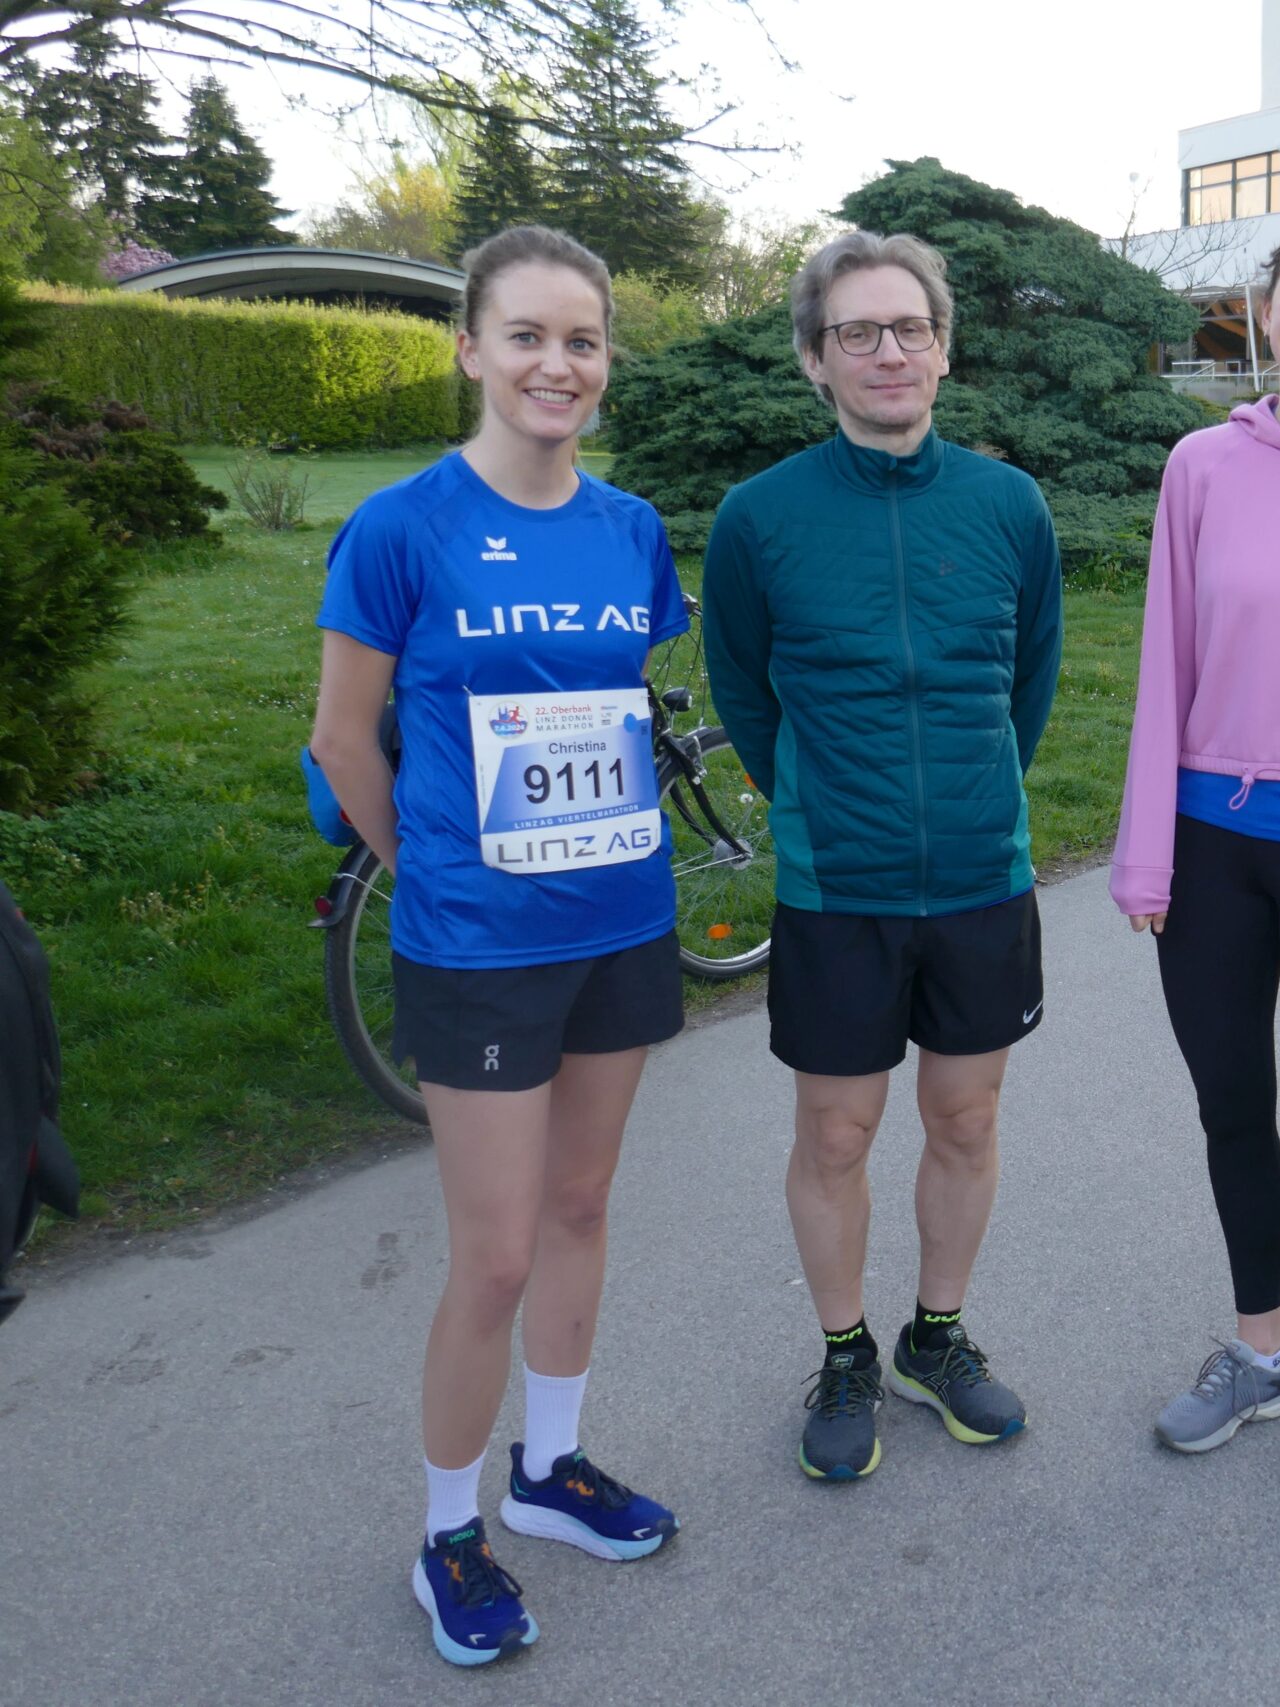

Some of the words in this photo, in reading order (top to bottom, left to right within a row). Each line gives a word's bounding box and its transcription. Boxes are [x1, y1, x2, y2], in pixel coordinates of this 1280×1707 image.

[481, 551, 517, 561] erima
[456, 604, 585, 637] LINZ
[596, 605, 650, 634] AG
[535, 706, 549, 716] 22.
[551, 703, 592, 715] Oberbank
[535, 715, 557, 724] LINZ
[561, 714, 593, 722] DONAU
[536, 722, 594, 731] MARATHON
[548, 740, 607, 755] Christina
[523, 758, 625, 805] 9111
[558, 804, 639, 824] VIERTELMARATHON
[498, 835, 597, 864] LINZ
[606, 828, 651, 854] AG
